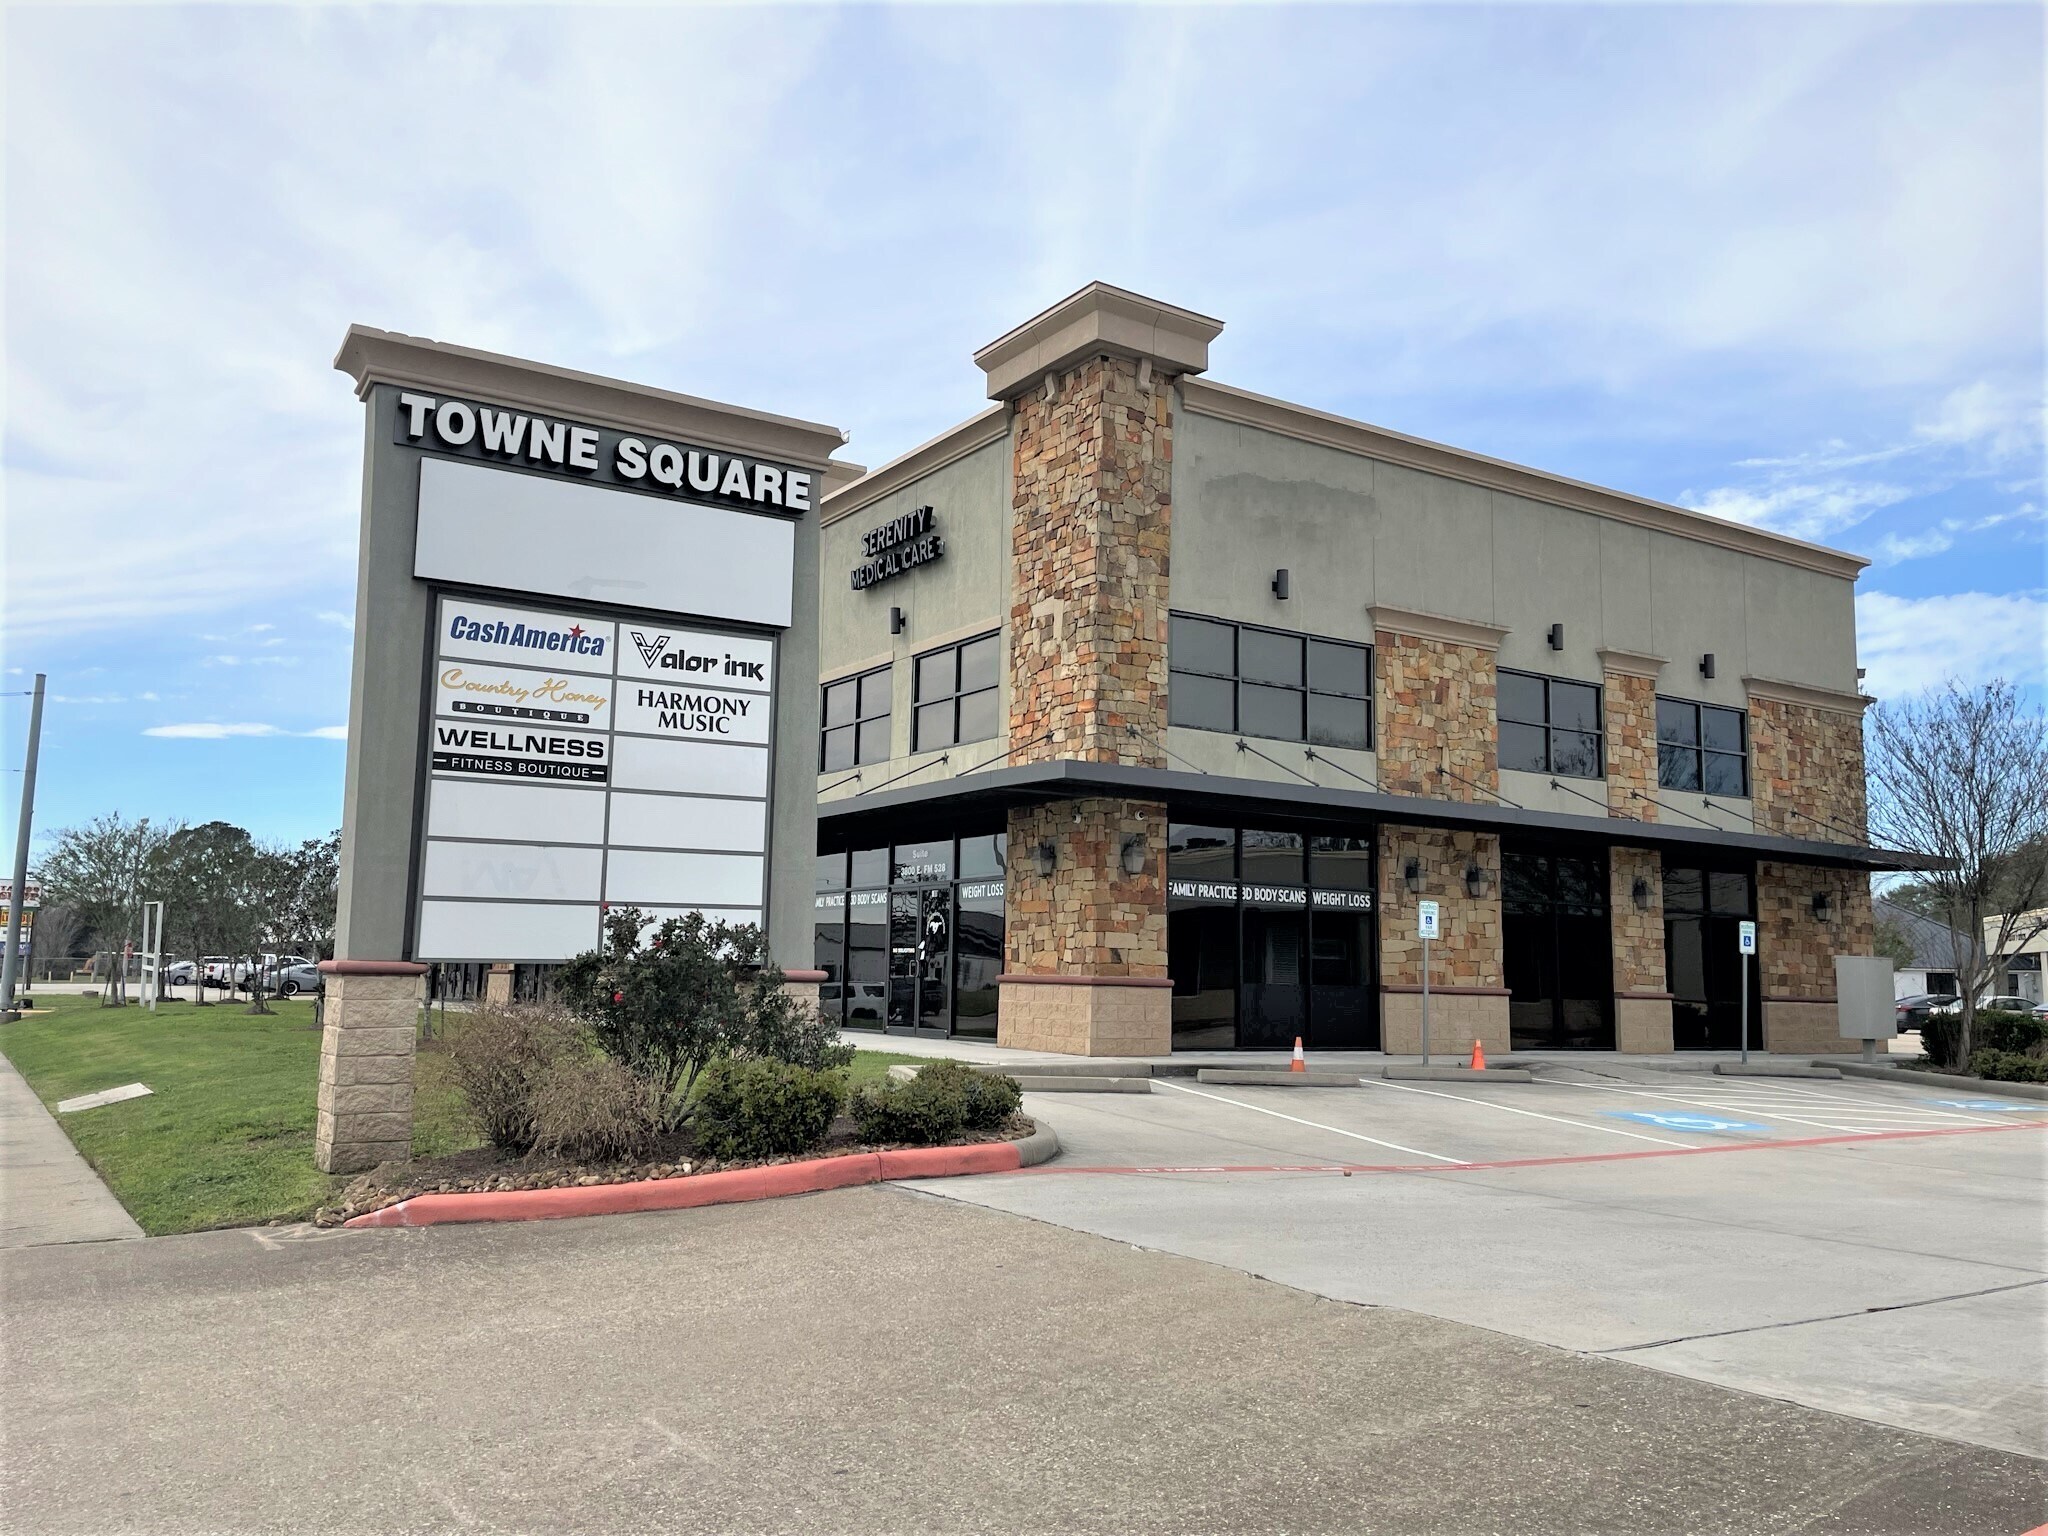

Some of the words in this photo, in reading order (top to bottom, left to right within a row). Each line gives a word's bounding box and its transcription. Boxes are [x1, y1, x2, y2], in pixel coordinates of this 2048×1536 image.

[401, 392, 599, 471] TOWNE
[616, 437, 811, 511] SQUARE
[861, 505, 929, 557] SERENITY
[851, 553, 900, 590] MEDICAL
[902, 537, 936, 569] CARE
[630, 631, 718, 673] Valor
[725, 654, 765, 682] ink
[441, 668, 529, 702] Country
[533, 678, 608, 711] Honey
[458, 702, 586, 723] BOUTIQUE
[638, 690, 751, 717] HARMONY
[658, 712, 730, 734] MUSIC
[438, 727, 604, 758] WELLNESS
[452, 758, 513, 773] FITNESS
[518, 763, 590, 778] BOUTIQUE
[934, 863, 946, 873] 528
[826, 895, 845, 906] PRACTICE
[858, 894, 870, 905] BODY
[871, 893, 887, 904] SCANS
[962, 885, 986, 898] WEIGHT
[987, 884, 1004, 897] LOSS
[1199, 884, 1237, 899] PRACTICE
[1254, 887, 1278, 902] BODY
[1278, 889, 1306, 904] SCANS
[1312, 891, 1346, 906] WEIGHT
[1348, 894, 1371, 908] LOSS
